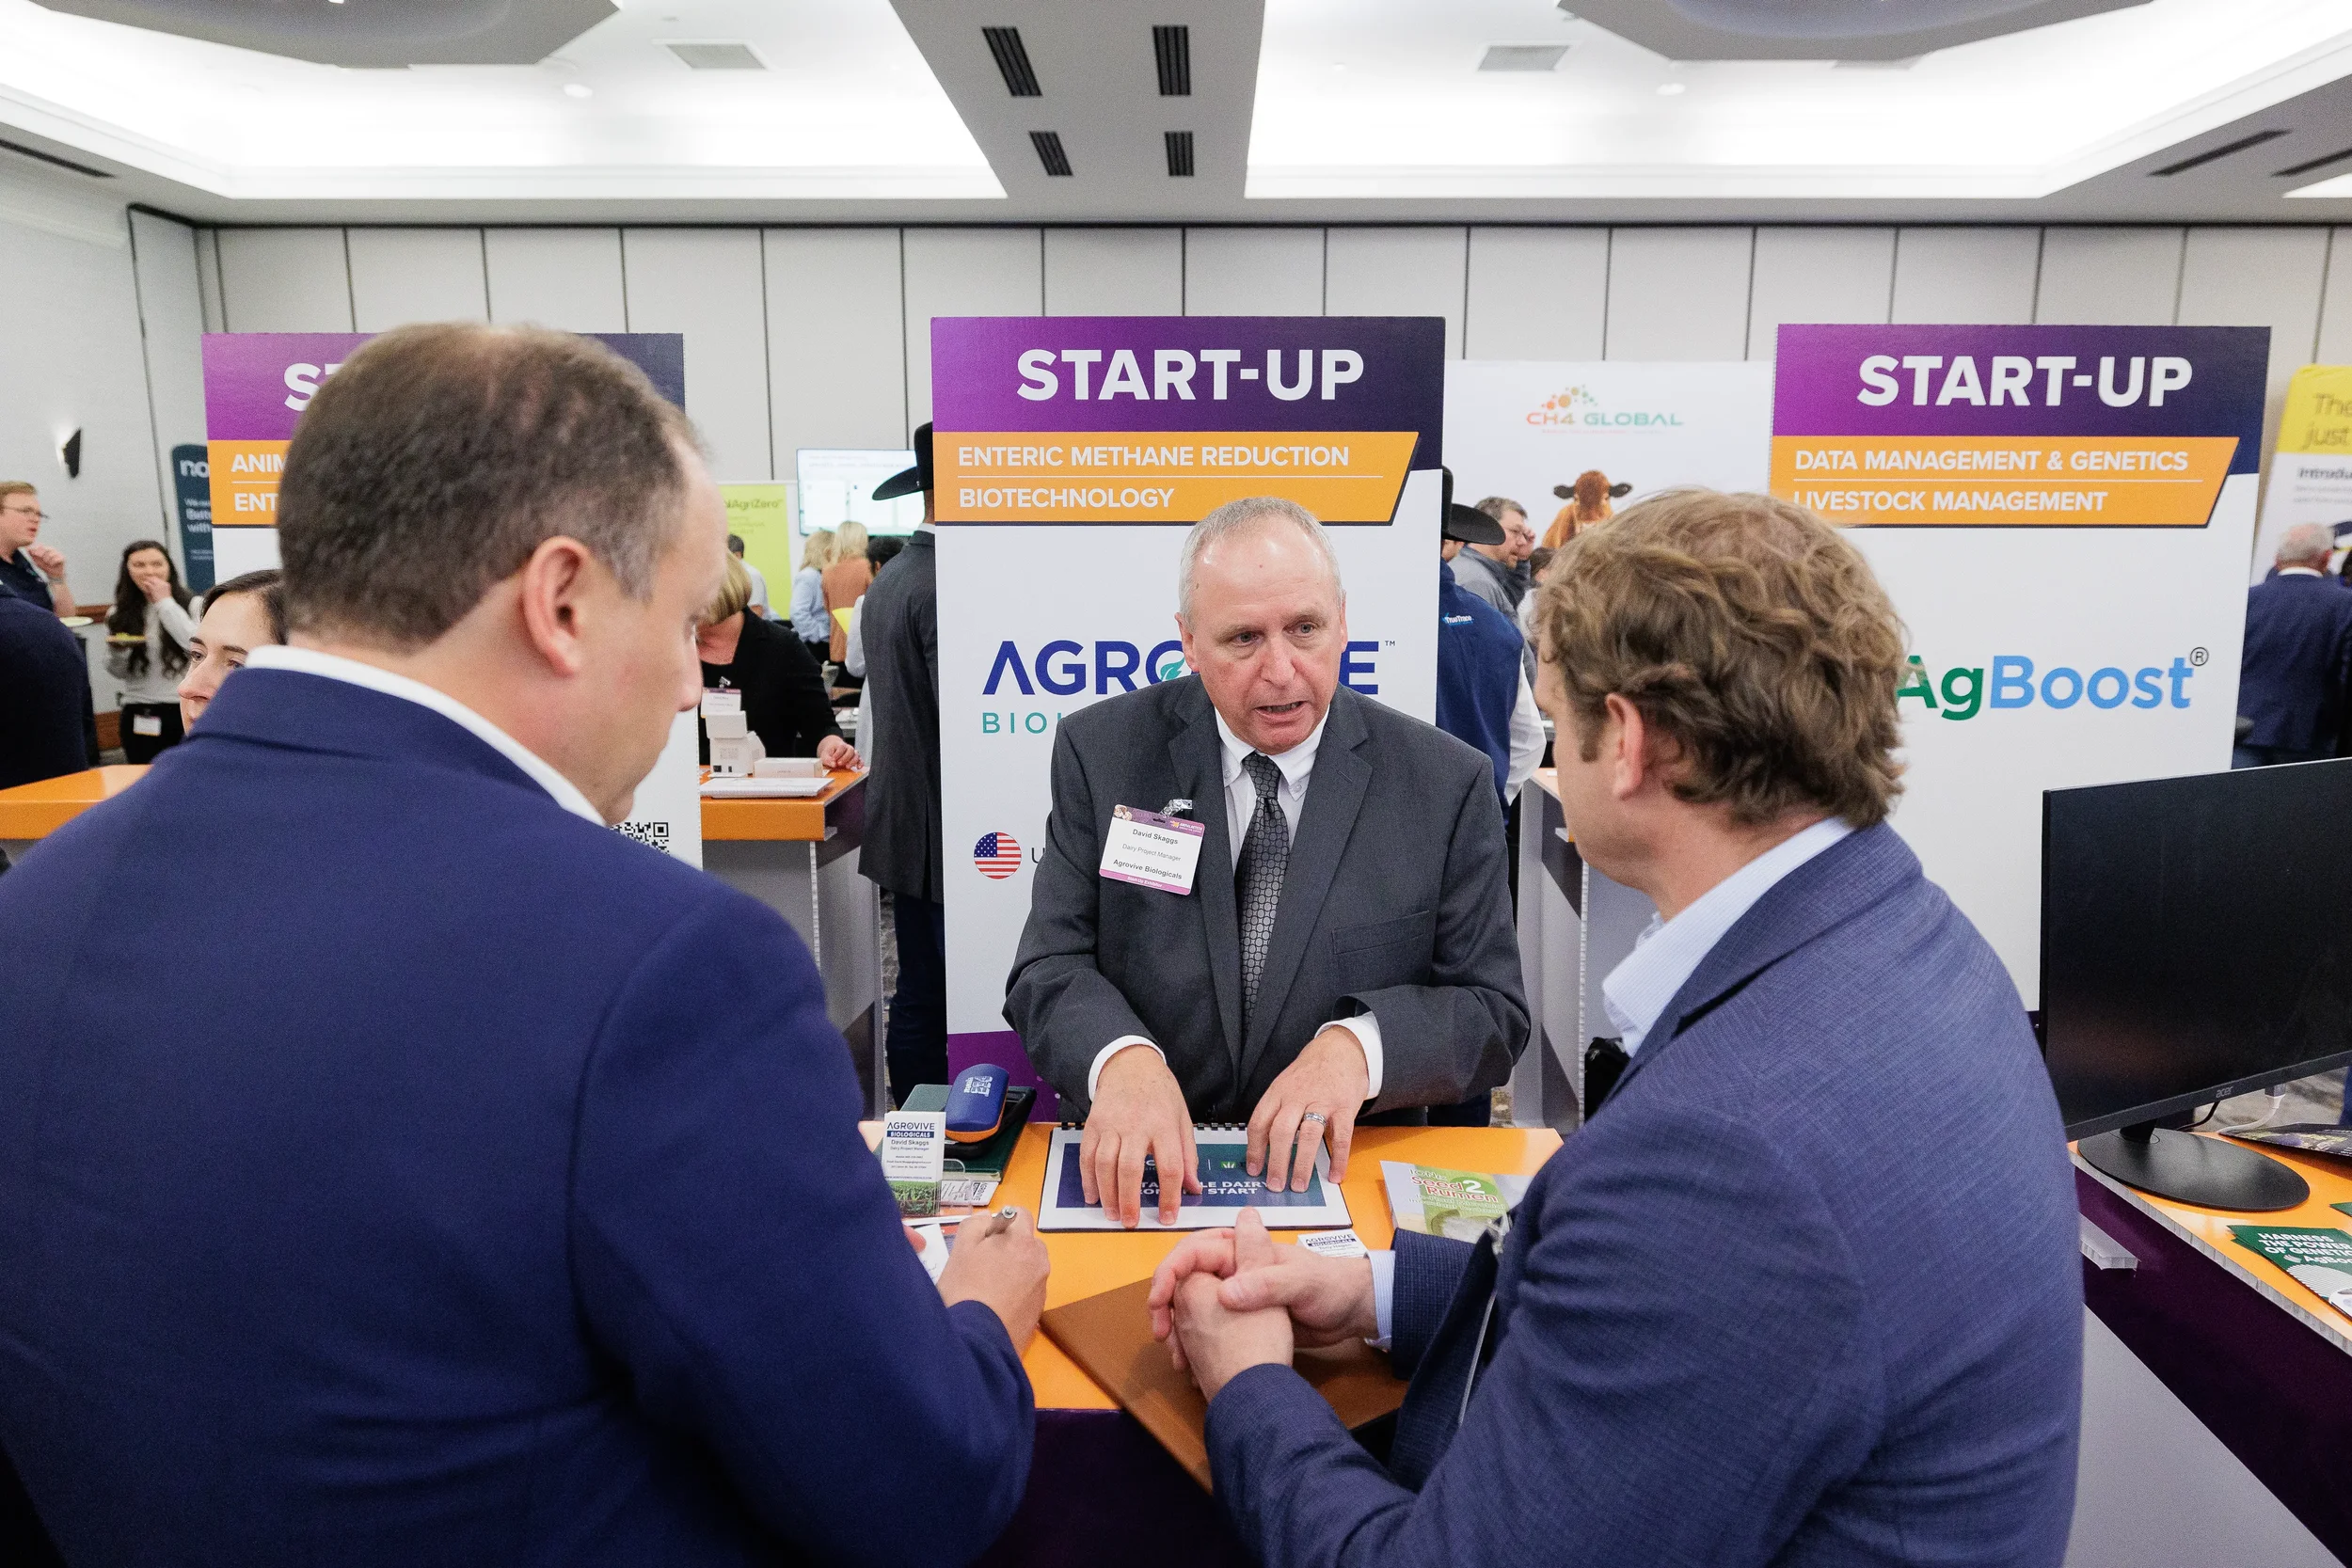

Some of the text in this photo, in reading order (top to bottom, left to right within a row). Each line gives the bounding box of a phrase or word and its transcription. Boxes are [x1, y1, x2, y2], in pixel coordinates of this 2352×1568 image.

[1016, 349, 1364, 401] START-UP
[1857, 355, 2193, 407] START-UP
[1526, 412, 1684, 426] CH4 GLOBAL
[958, 447, 1349, 467] ENTERIC METHANE REDUCTION
[1795, 451, 2189, 471] DATA MANAGEMENT & GENETICS
[960, 488, 1175, 508] BIOTECHNOLOGY
[1932, 491, 2108, 512] MANAGEMENT
[1896, 655, 2194, 721] AgBoost
[1132, 829, 1179, 845] David Skaggs
[1122, 843, 1182, 862] Dairy Project Manager
[1113, 859, 1183, 879] Agrovive Biologicals
[2216, 1085, 2233, 1099] acer
[1411, 1176, 1486, 1195] Seed 2
[1426, 1186, 1499, 1203] Rumen
[2258, 1233, 2334, 1243] HARNESS
[2292, 1241, 2352, 1249] POWER
